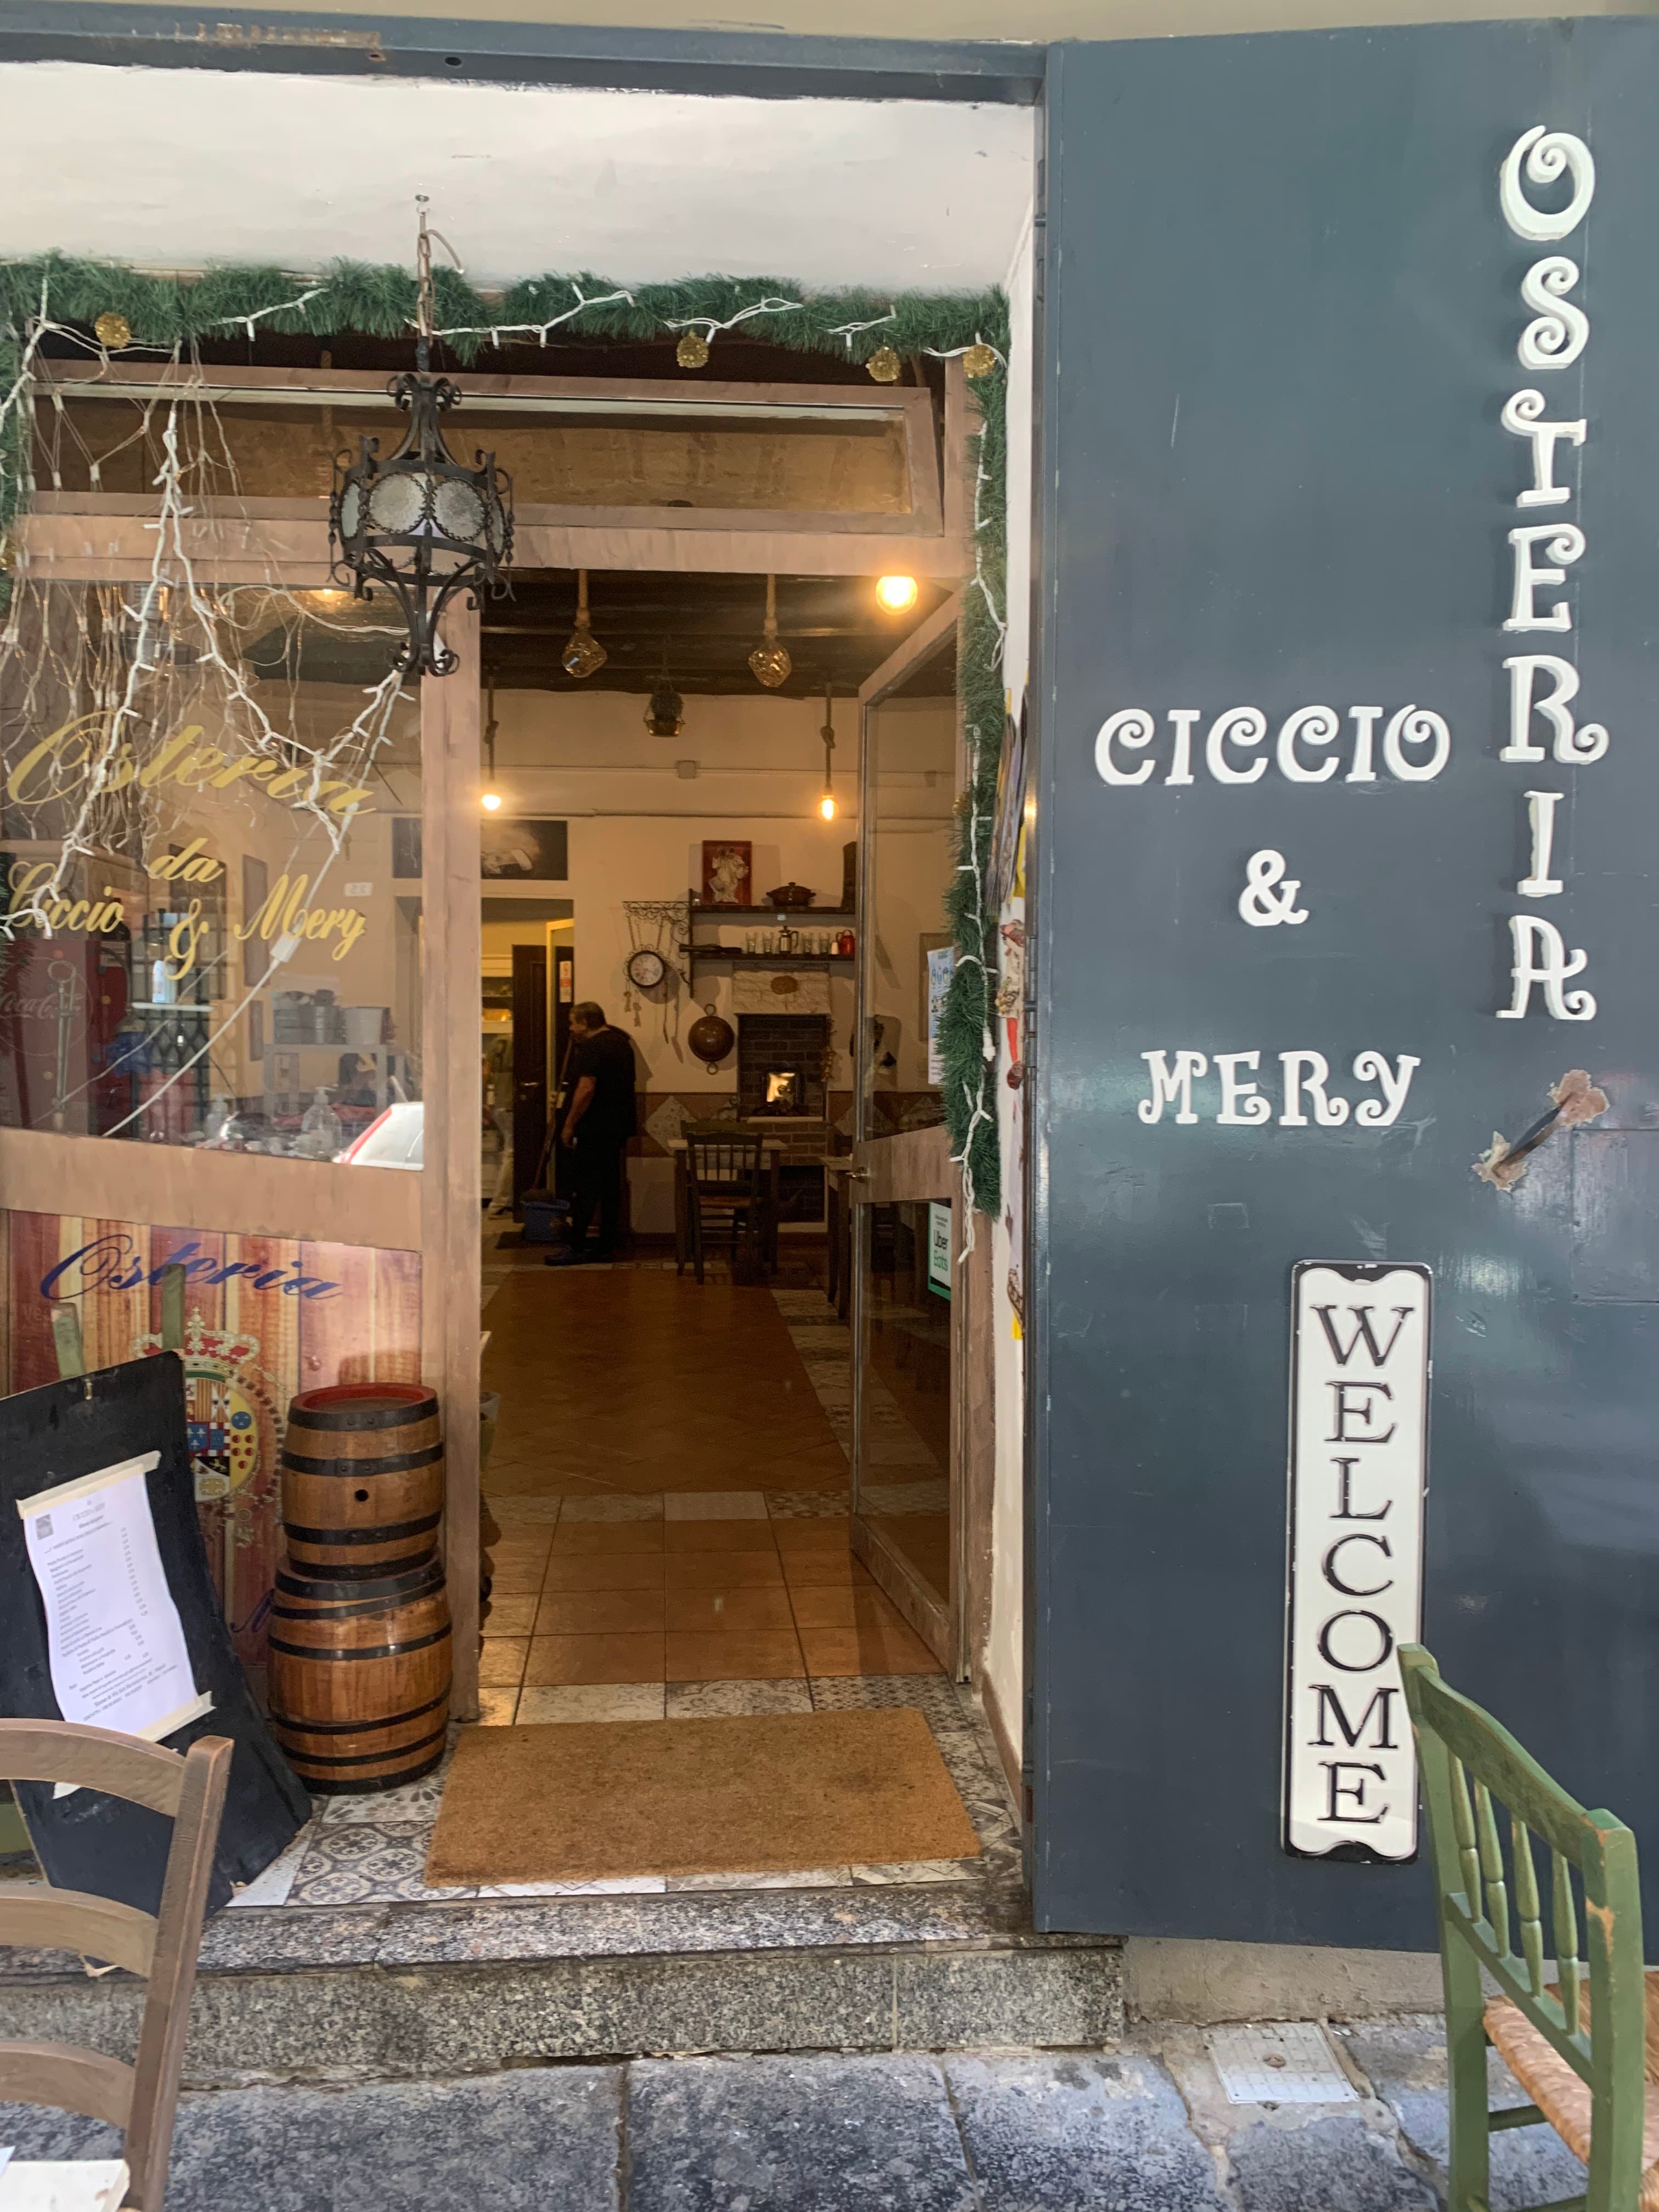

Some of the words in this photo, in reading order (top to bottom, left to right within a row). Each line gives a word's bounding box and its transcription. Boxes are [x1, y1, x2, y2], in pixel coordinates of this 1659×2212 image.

[1496, 125, 1610, 1022] OSTERIA
[7, 711, 377, 816] Osteria
[1094, 704, 1451, 786] CICCIO
[149, 838, 224, 882] da
[1239, 849, 1310, 927] &
[8, 861, 124, 933] Ciccio
[234, 874, 366, 961] Mery
[1137, 1049, 1421, 1126] MERY
[41, 1234, 343, 1300] Osteria
[934, 1229, 949, 1250] Uber
[934, 1250, 949, 1272] Eats
[1308, 1305, 1414, 1824] WELCOME
